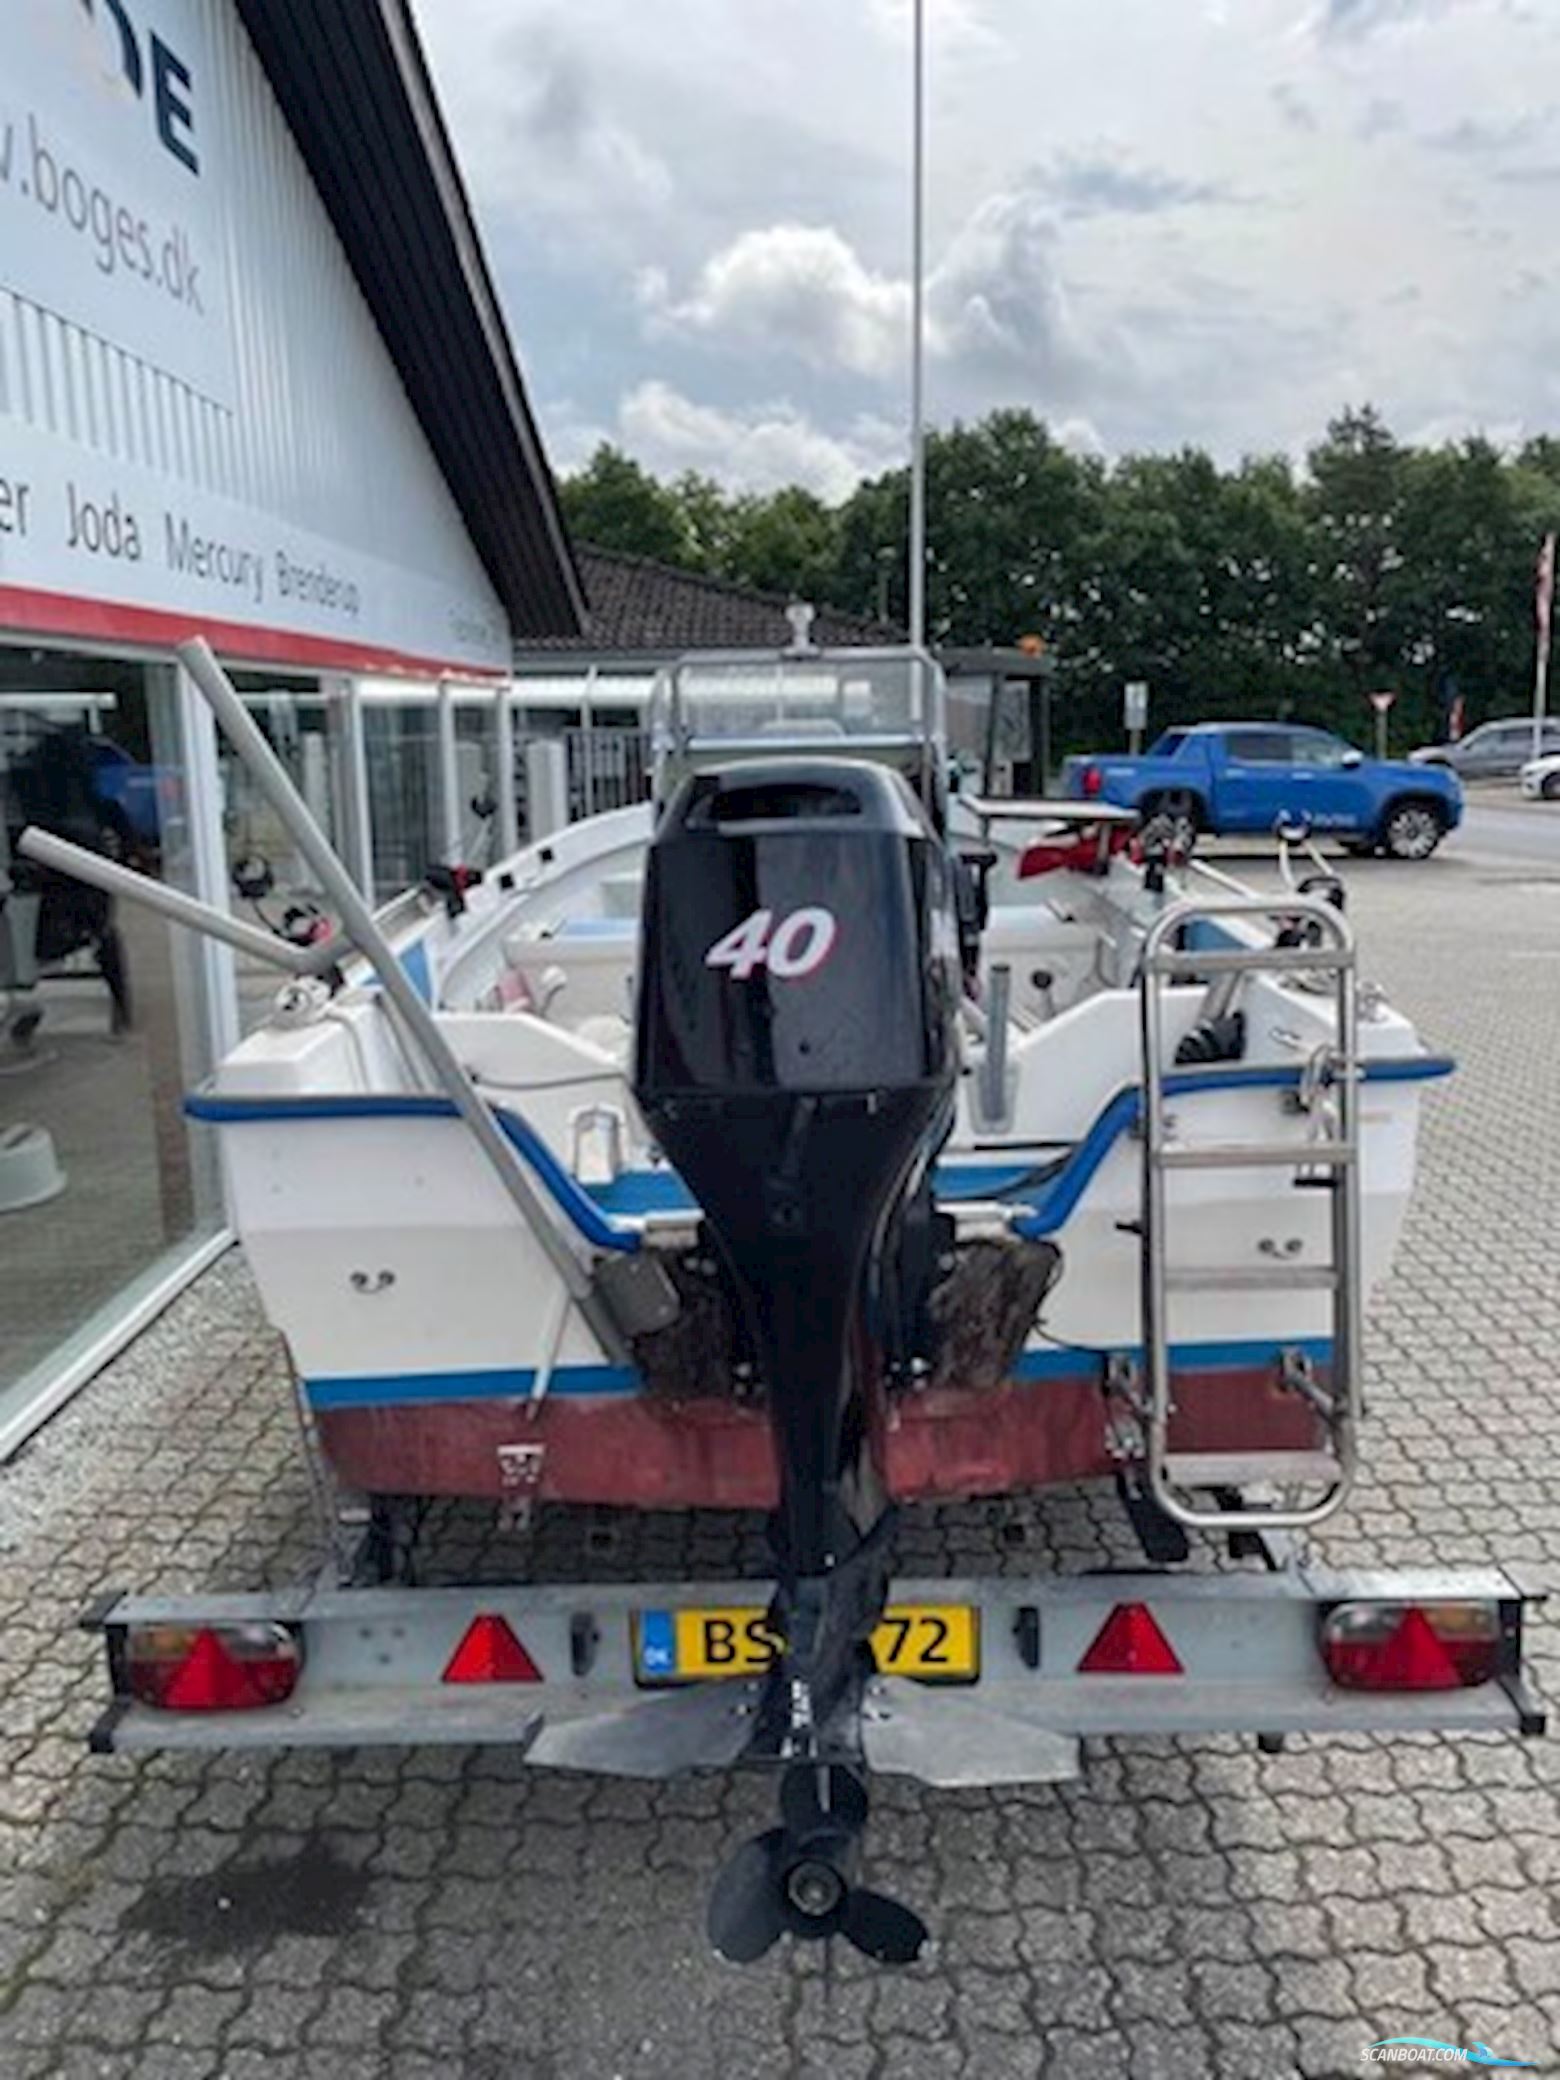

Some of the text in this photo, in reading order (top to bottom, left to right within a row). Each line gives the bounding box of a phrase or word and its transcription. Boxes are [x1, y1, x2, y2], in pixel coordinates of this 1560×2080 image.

[67, 481, 142, 561] Joda
[165, 512, 264, 603] Mercury
[705, 906, 838, 978] 40
